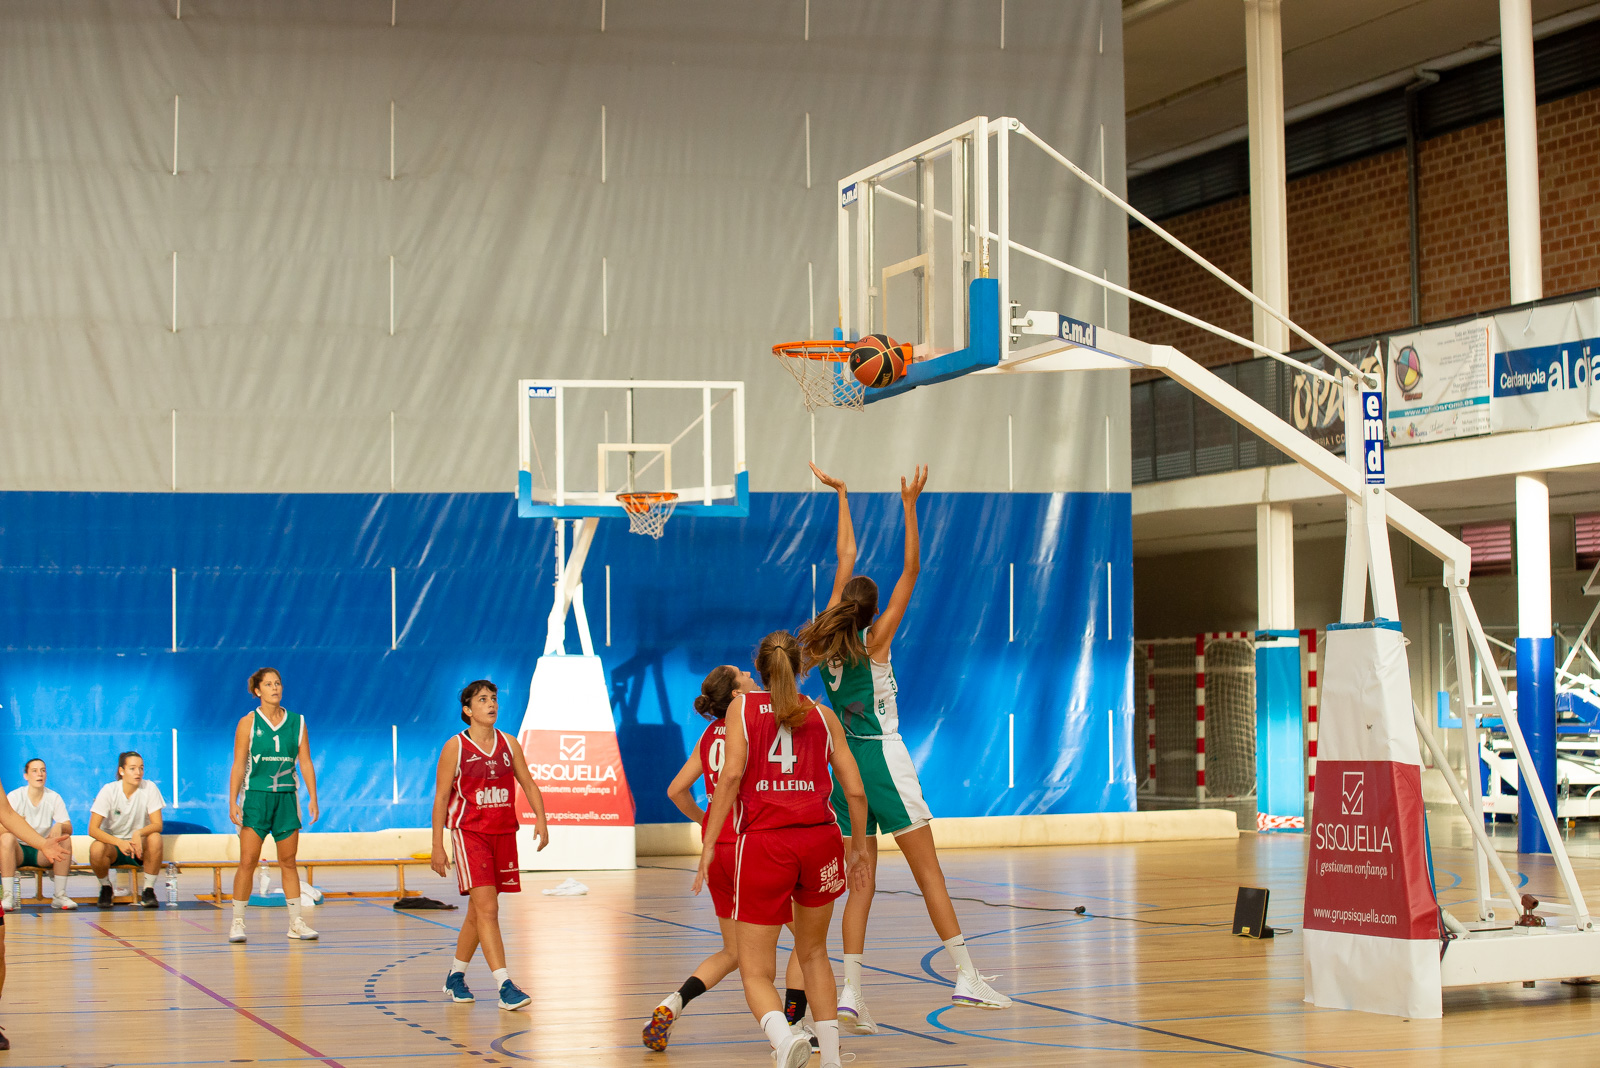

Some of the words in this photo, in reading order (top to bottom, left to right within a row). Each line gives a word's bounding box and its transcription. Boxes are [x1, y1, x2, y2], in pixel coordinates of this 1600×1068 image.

[1500, 368, 1546, 390] Cerdanyola
[1548, 350, 1570, 391] al
[272, 734, 280, 753] 1
[768, 721, 798, 775] 4
[502, 752, 511, 767] 8
[528, 763, 618, 782] SISQUELLA
[773, 779, 815, 792] LLEIDA
[476, 786, 510, 806] ekke
[1316, 822, 1393, 854] SISQUELLA
[820, 861, 838, 882] SON
[1320, 860, 1354, 877] gestionem
[1354, 860, 1388, 880] confiança
[1313, 907, 1397, 926] www.grupsisquella.com
